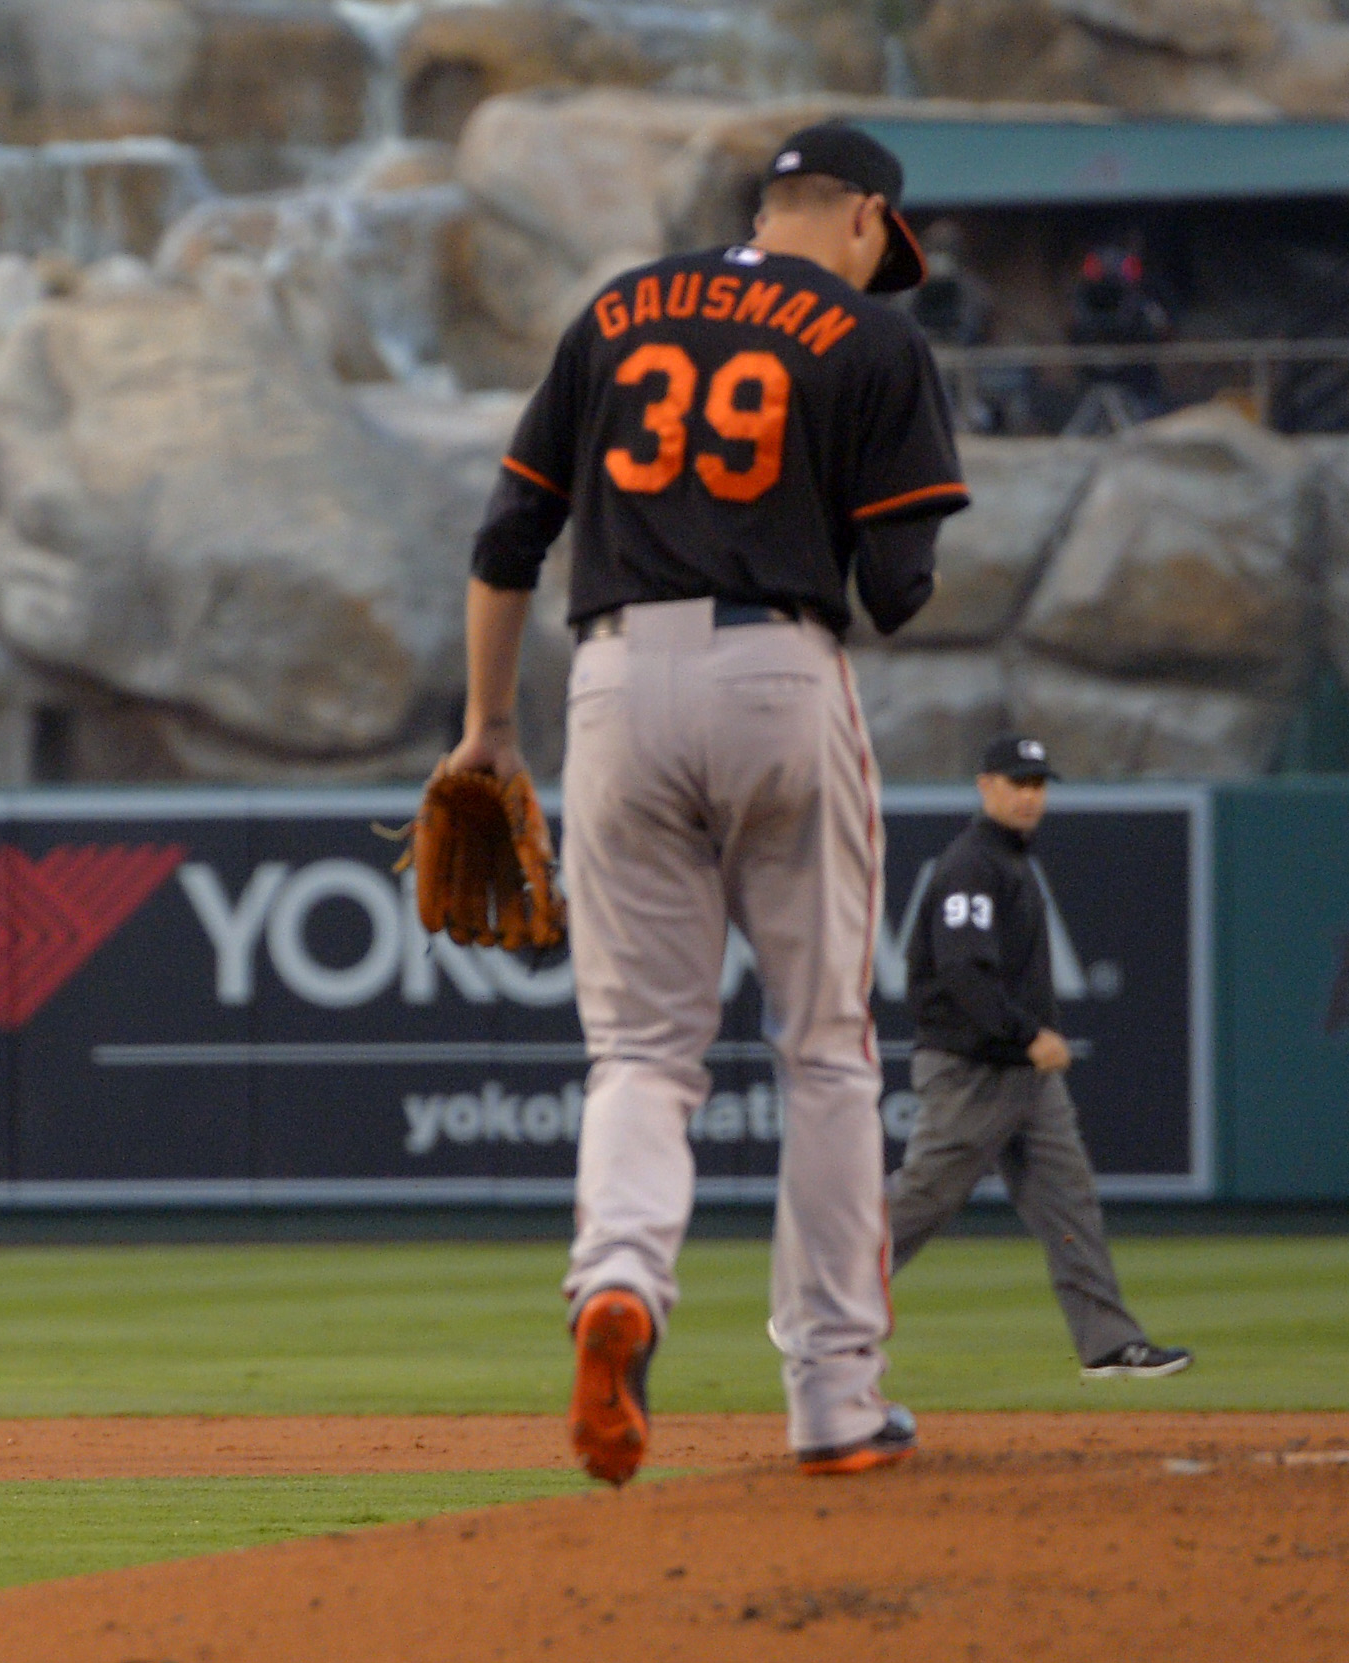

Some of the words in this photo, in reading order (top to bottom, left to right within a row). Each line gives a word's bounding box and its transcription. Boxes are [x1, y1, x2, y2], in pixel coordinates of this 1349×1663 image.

[594, 272, 857, 357] GAUSMAN
[604, 342, 791, 502] 39
[943, 891, 994, 931] 93
